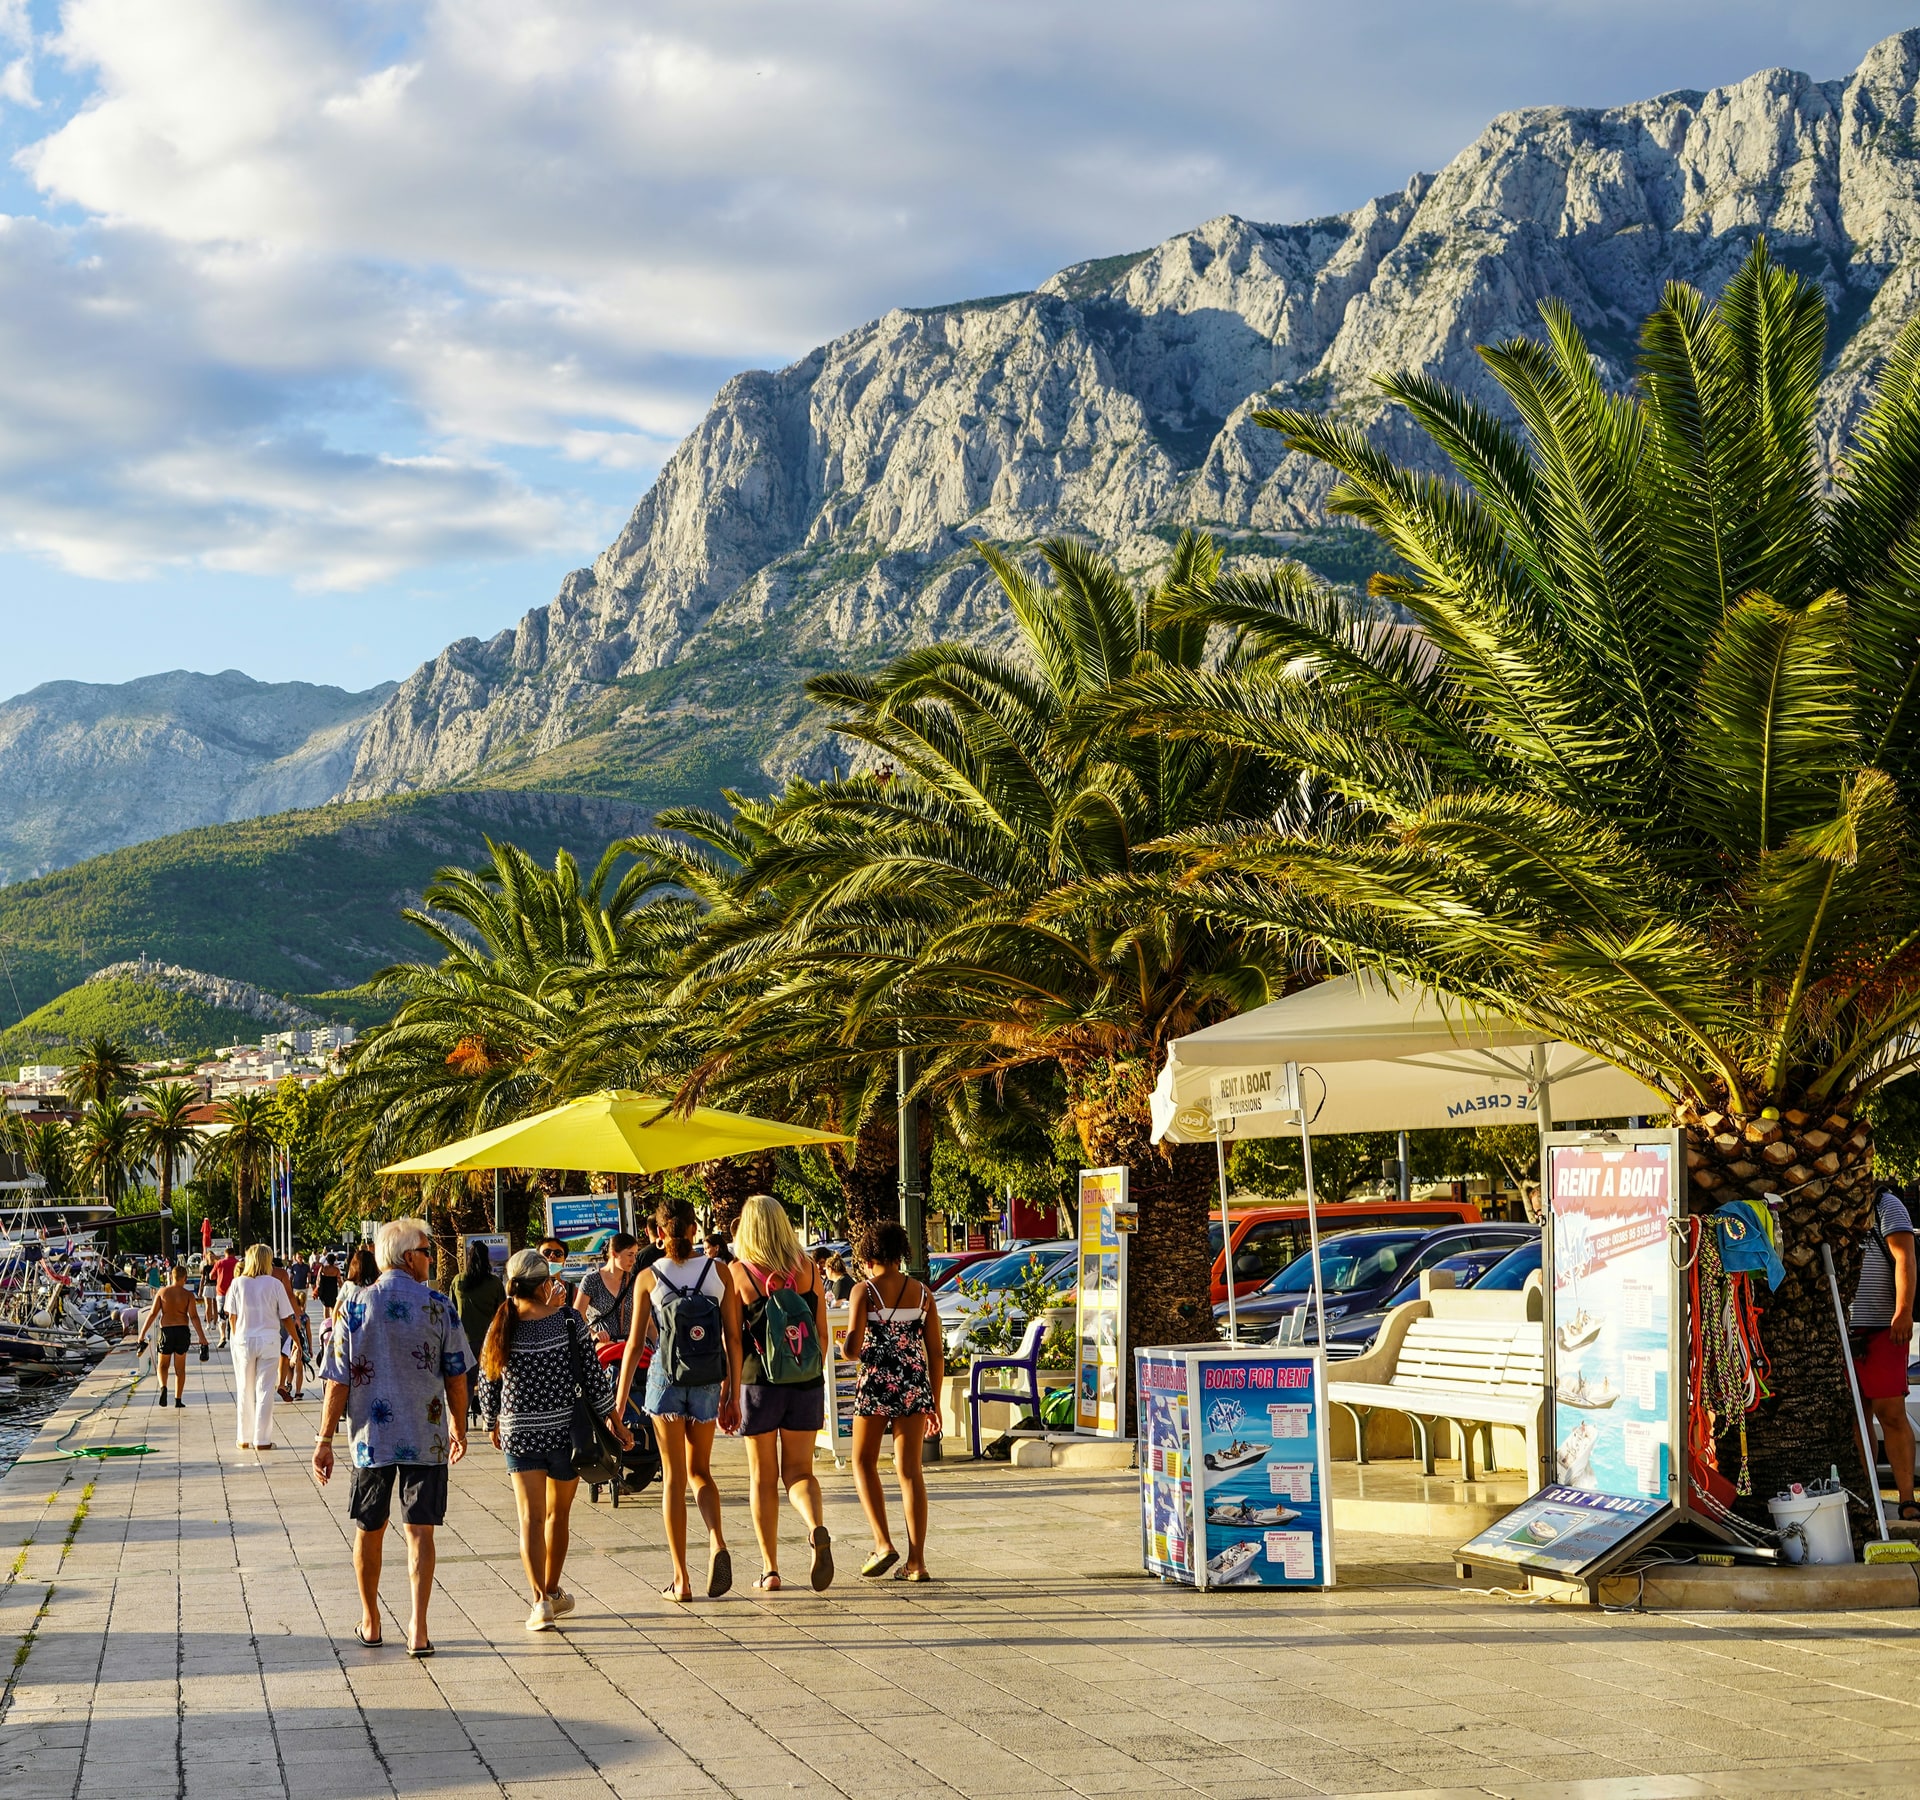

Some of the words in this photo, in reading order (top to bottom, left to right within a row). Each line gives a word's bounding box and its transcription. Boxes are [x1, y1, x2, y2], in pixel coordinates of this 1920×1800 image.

[1220, 1077, 1238, 1099] RENT
[1239, 1075, 1246, 1095] A
[1246, 1071, 1271, 1094] BOAT
[1229, 1097, 1262, 1115] EXCURSIONS
[1557, 1167, 1602, 1197] RENT
[1602, 1167, 1615, 1197] A
[1619, 1166, 1664, 1197] BOAT
[1084, 1189, 1098, 1204] RENT
[1205, 1368, 1246, 1389] BOATS
[1248, 1368, 1274, 1389] FOR
[1277, 1367, 1311, 1388] RENT
[1546, 1488, 1590, 1504] RENT
[1588, 1495, 1604, 1507] A
[1604, 1497, 1650, 1513] BOAT
